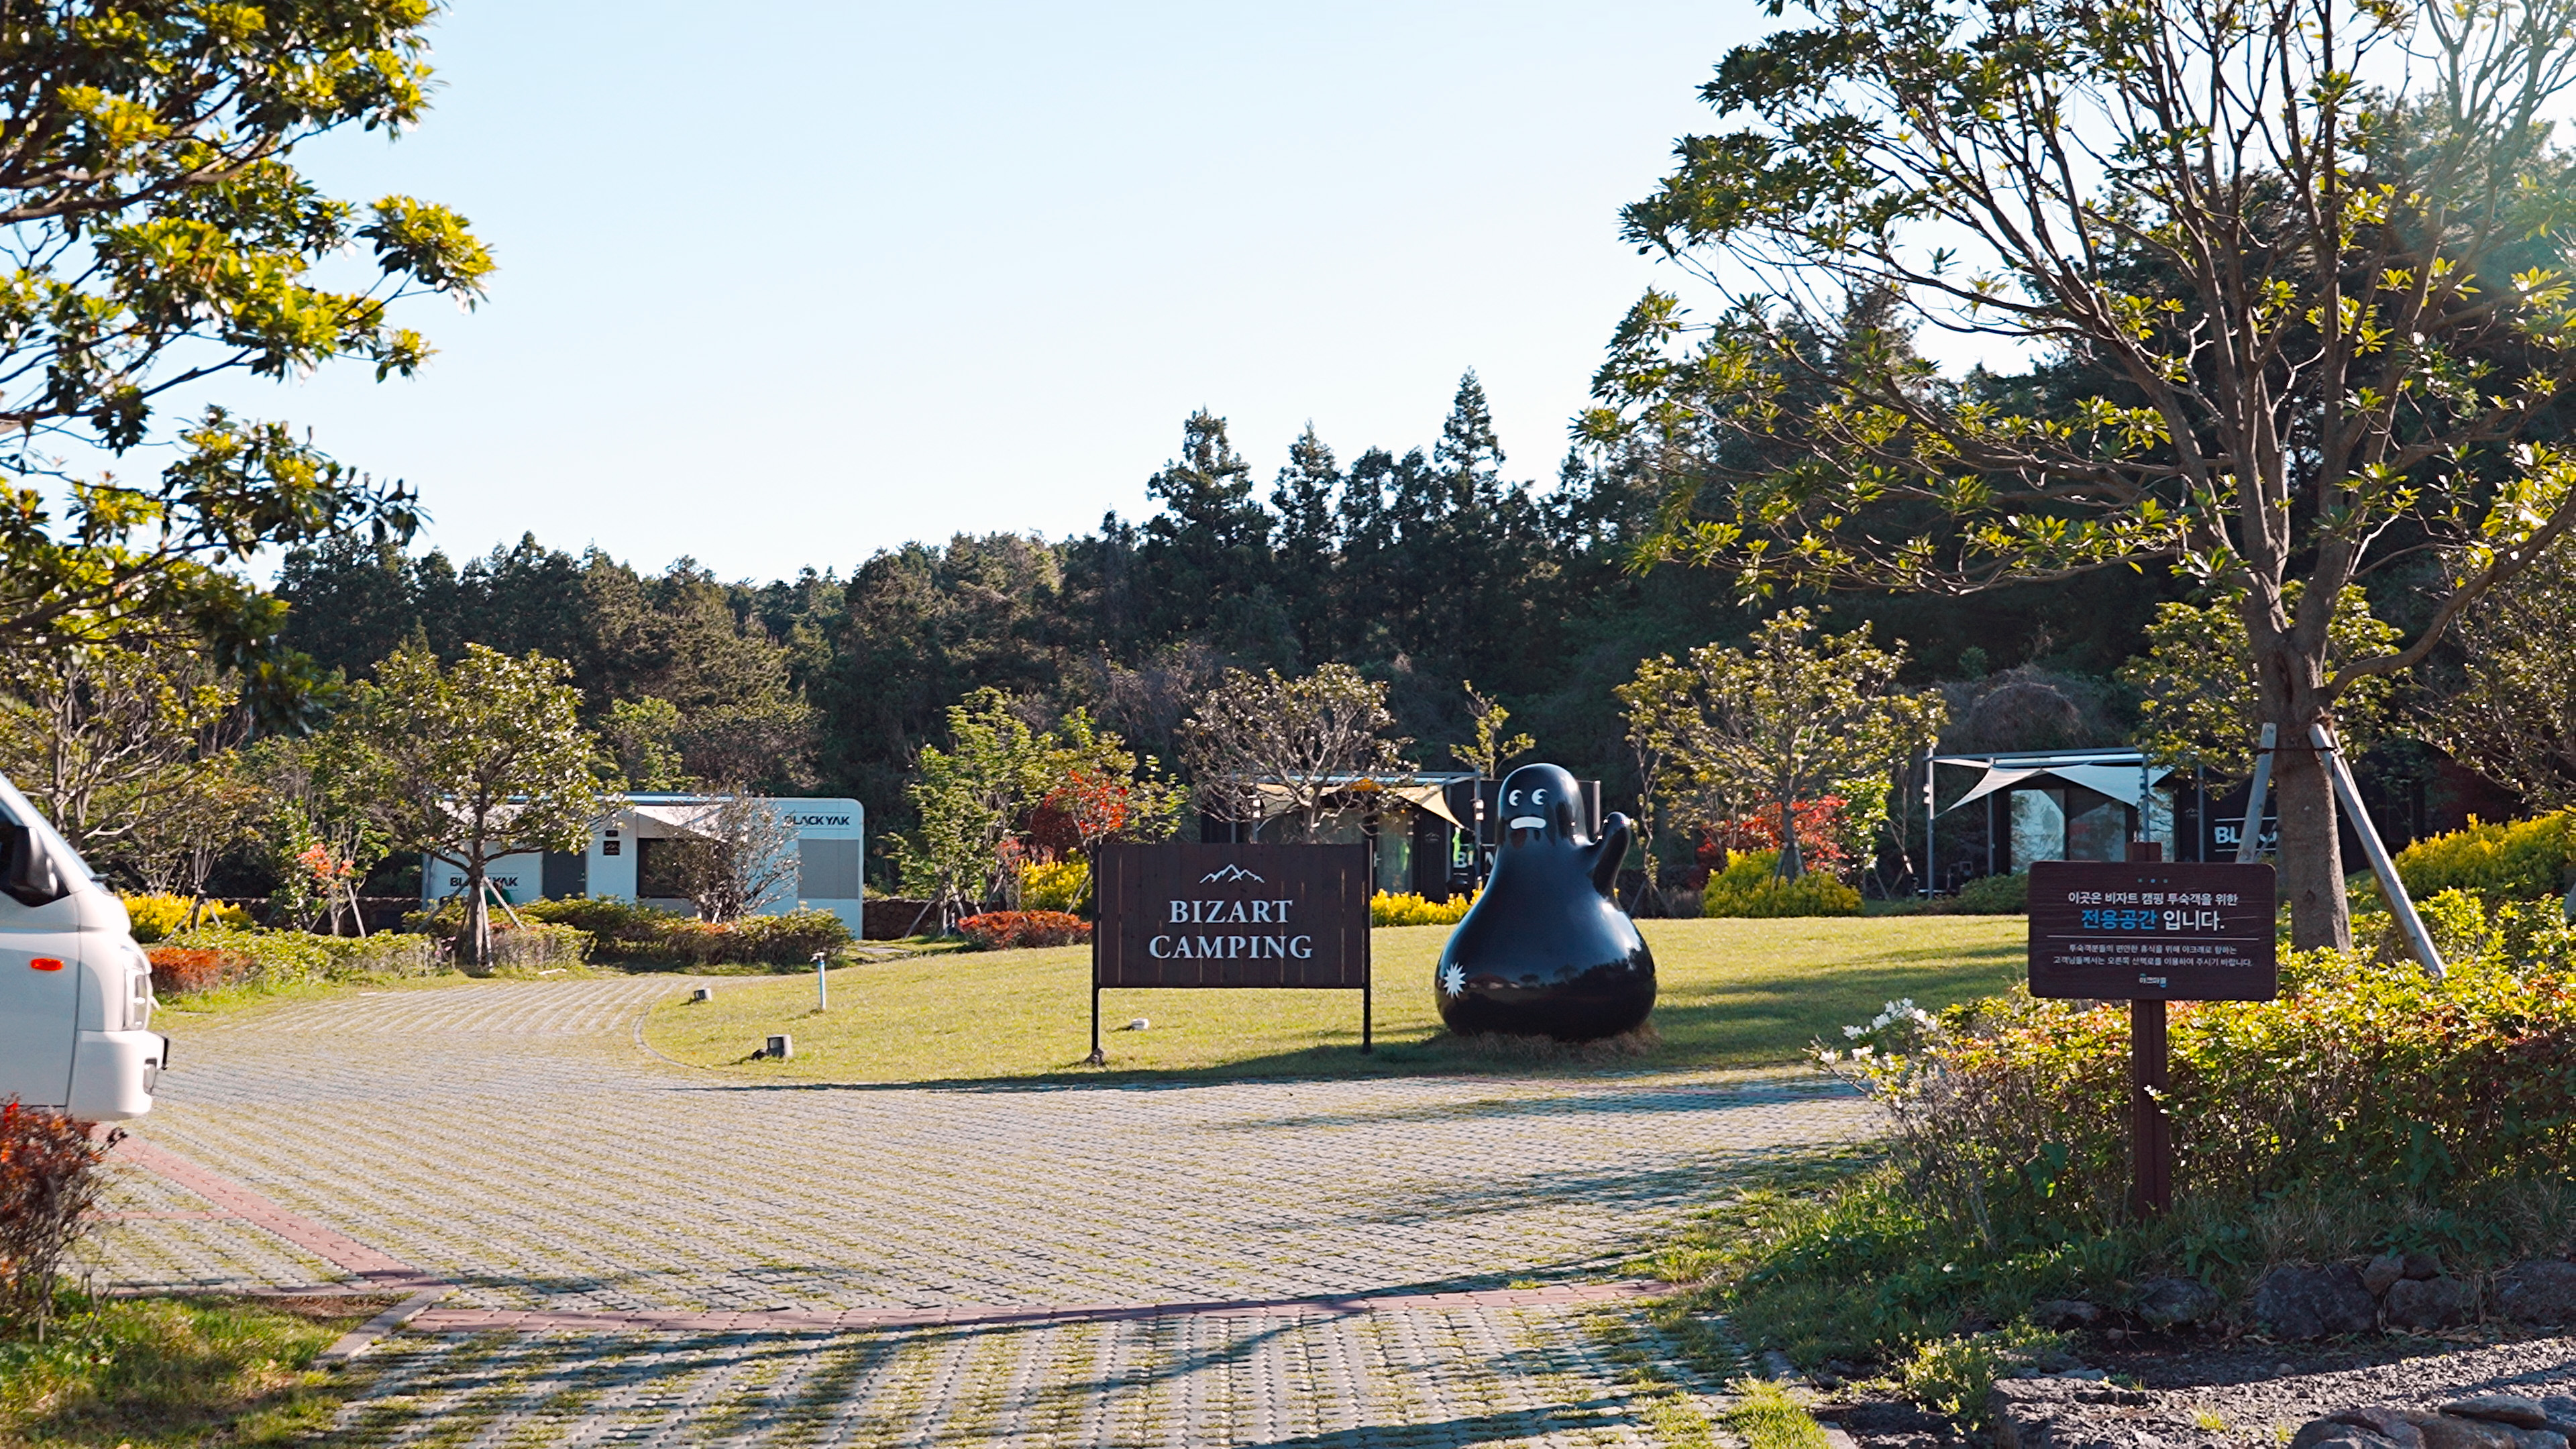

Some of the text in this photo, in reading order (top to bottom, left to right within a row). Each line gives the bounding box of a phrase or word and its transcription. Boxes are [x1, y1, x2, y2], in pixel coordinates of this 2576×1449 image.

[2068, 891, 2239, 906] 이곳은 비자트 캠핑 투숙객을 위한
[1169, 900, 1293, 924] BIZART
[2081, 908, 2225, 932] 전용공간 입니다.
[1148, 934, 1312, 959] CAMPING
[2141, 944, 2163, 954] 휴식을
[2165, 945, 2180, 954] 위해
[2214, 944, 2238, 955] 향하는
[2053, 955, 2253, 967] 고객님들께서는 오른쪽 산책로를 이용하여 주시기 바랍니다.
